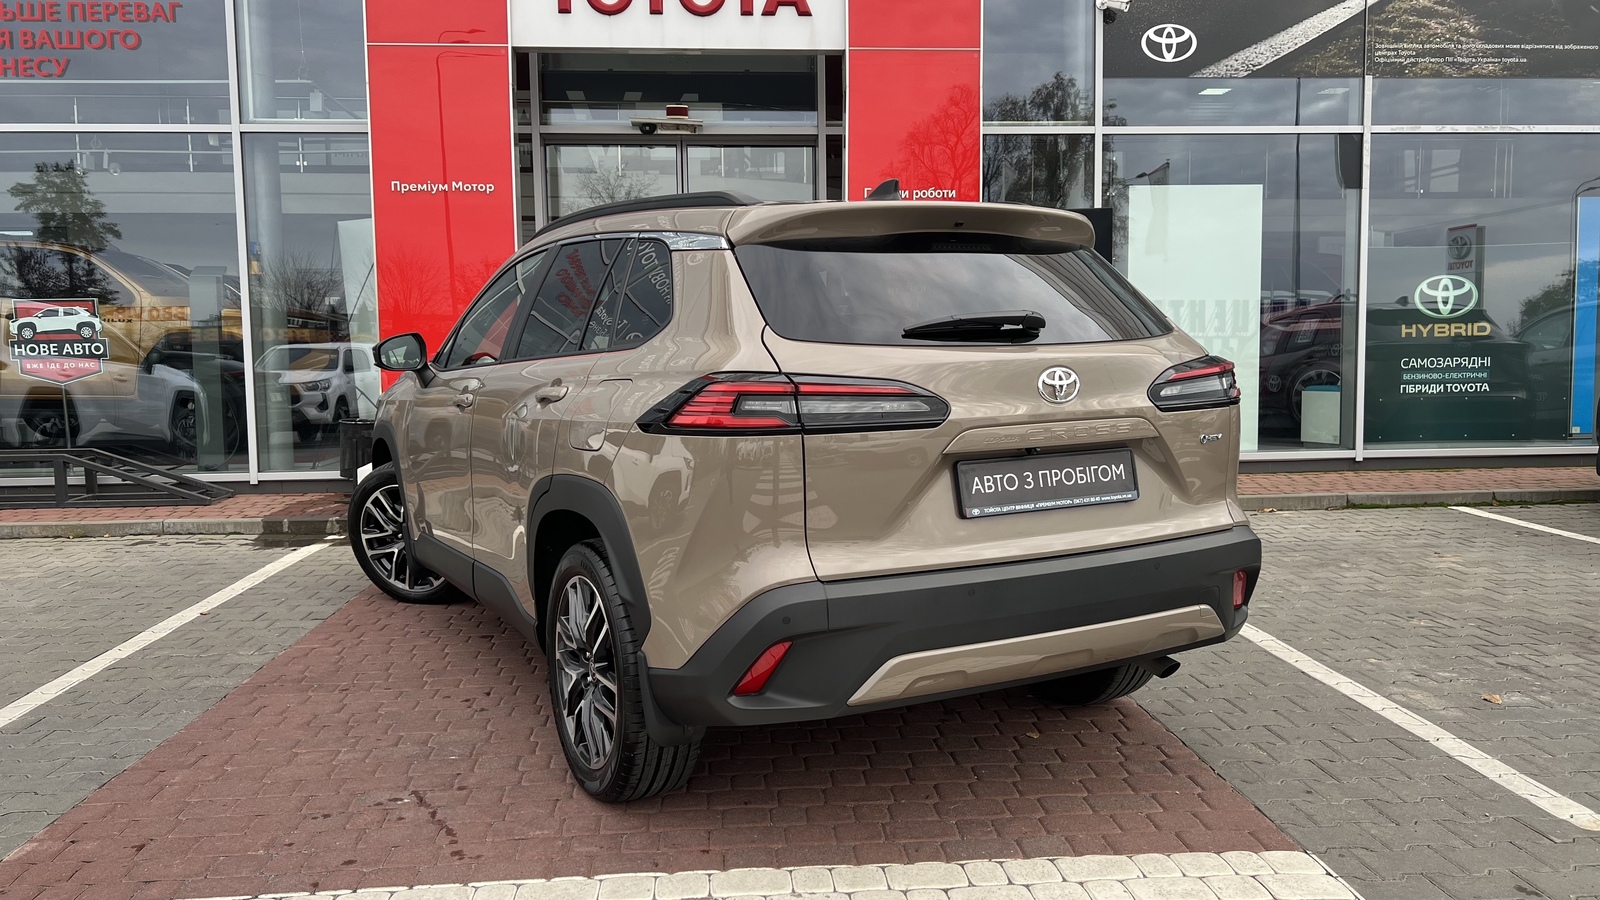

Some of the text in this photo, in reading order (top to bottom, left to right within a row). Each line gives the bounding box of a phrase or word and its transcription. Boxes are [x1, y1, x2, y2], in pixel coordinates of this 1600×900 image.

[67, 2, 182, 22] ПЕРЕВАГ
[19, 29, 141, 49] ВАШОГО
[391, 181, 495, 194] Преміум Мотор
[912, 187, 957, 200] роботи
[1400, 323, 1492, 338] HYBRID
[14, 342, 104, 356] НОВЕ АВТО
[46, 361, 61, 369] ЇДЕ
[1400, 356, 1491, 369] САМОЗАРЯДНІ
[1402, 372, 1488, 380] БЕНЗИНОВО-ЕЛЕКТРИЧНІ
[1400, 383, 1490, 395] ГІБРИДИ TOYOTA
[1026, 422, 1132, 441] CROSS
[971, 473, 1019, 495] АВТО
[1038, 463, 1126, 488] ПРОБІГОМ
